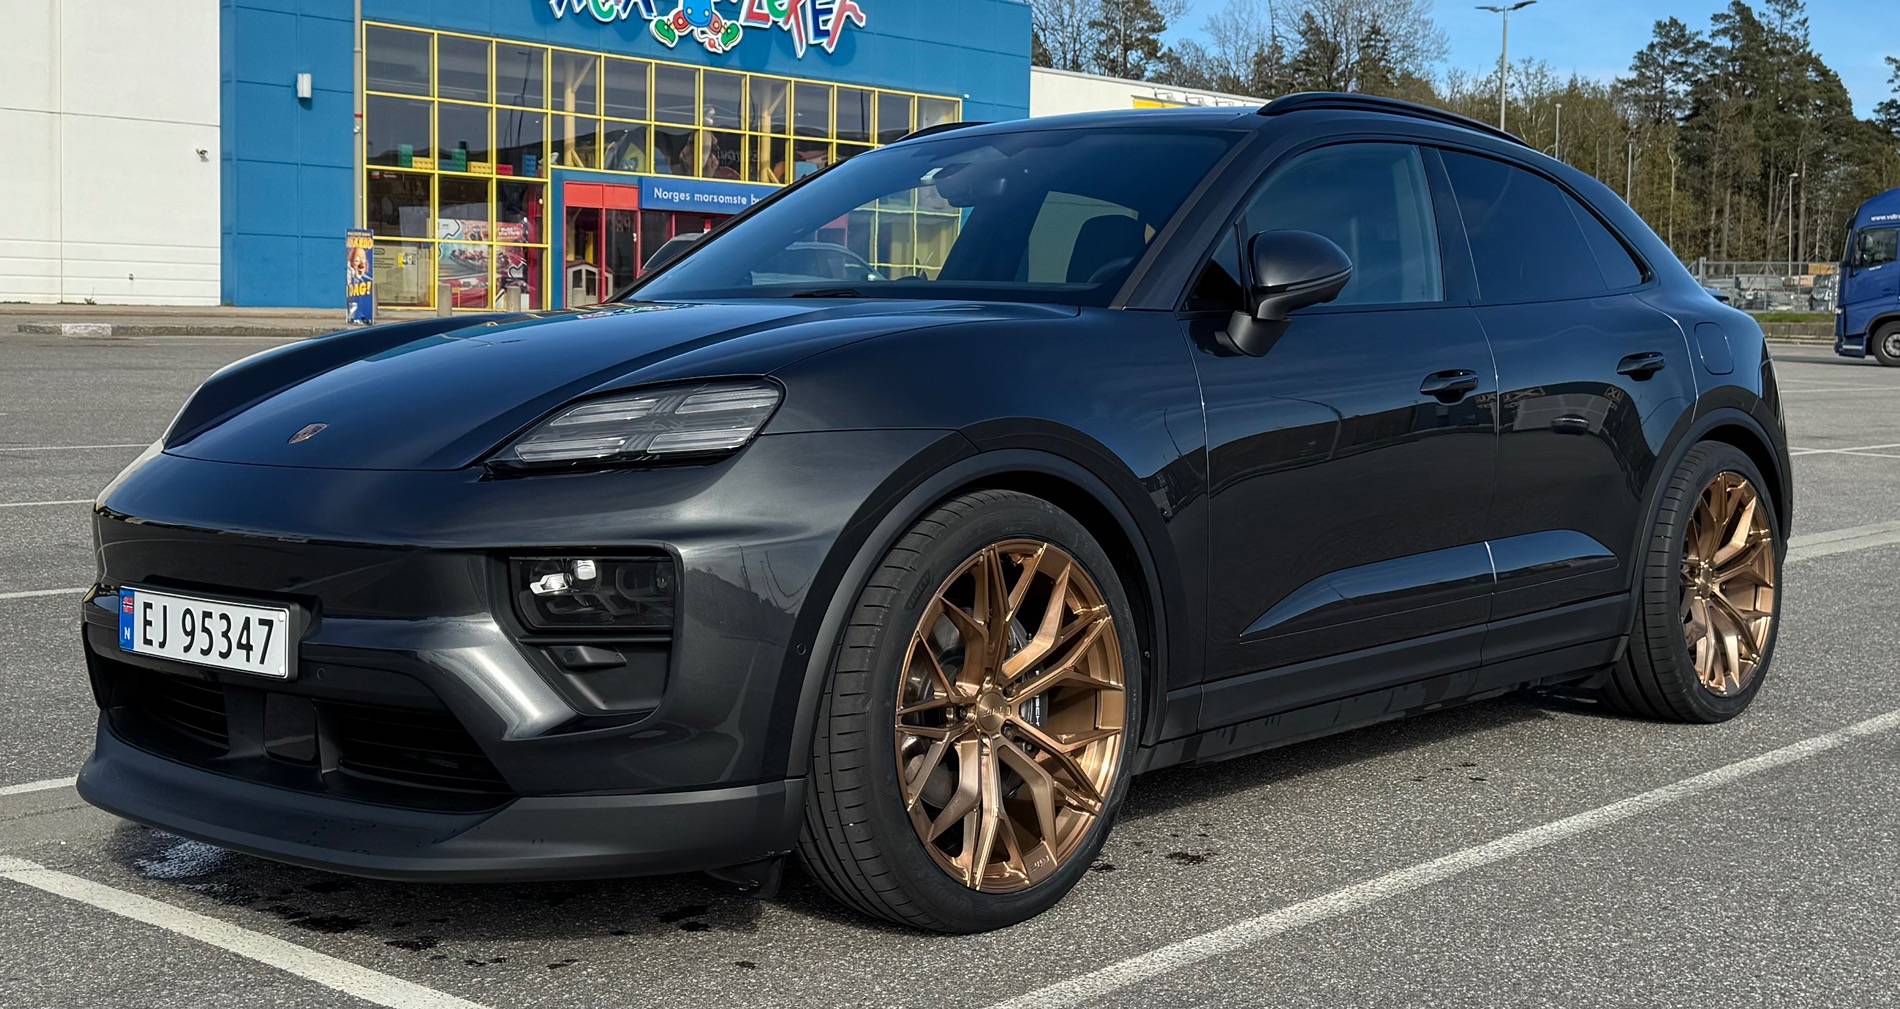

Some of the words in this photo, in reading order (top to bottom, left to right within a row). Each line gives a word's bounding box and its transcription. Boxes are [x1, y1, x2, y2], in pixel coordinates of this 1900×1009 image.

[654, 187, 690, 202] Norges
[694, 192, 747, 205] morsomste
[124, 627, 131, 640] N
[143, 601, 168, 649] EJ
[182, 607, 274, 665] 95347
